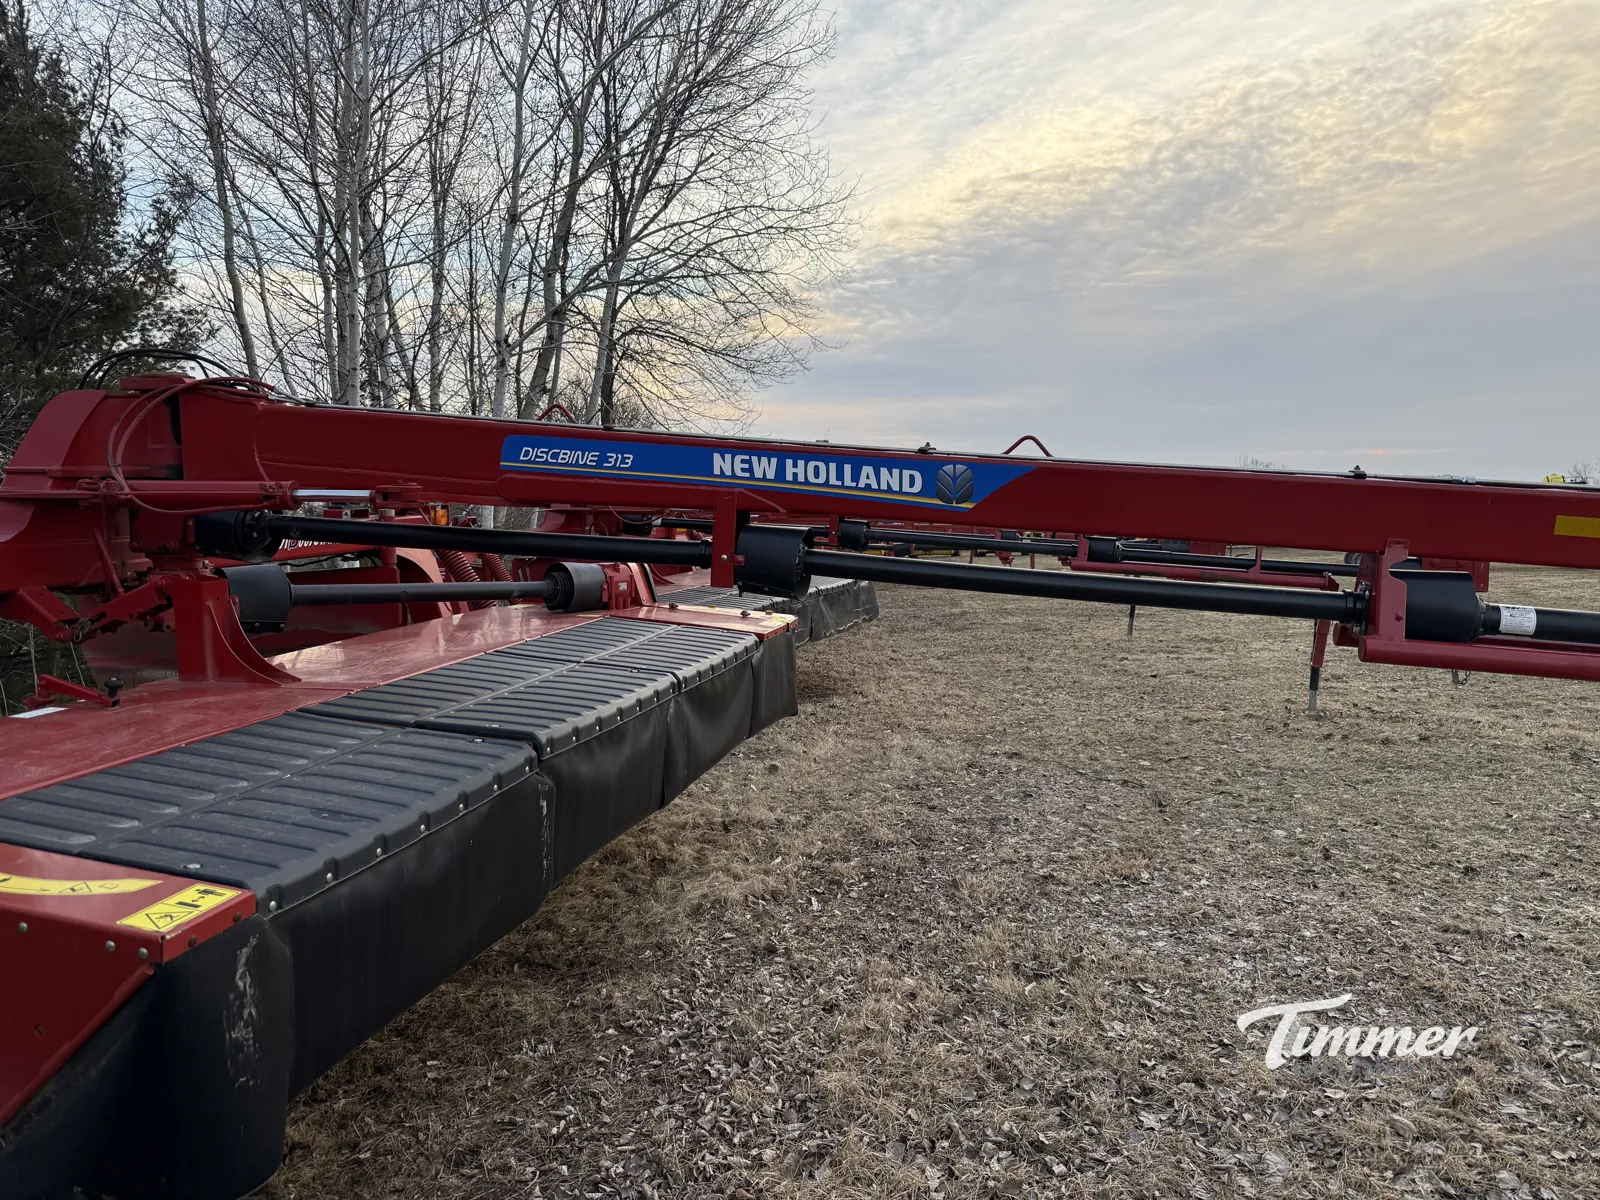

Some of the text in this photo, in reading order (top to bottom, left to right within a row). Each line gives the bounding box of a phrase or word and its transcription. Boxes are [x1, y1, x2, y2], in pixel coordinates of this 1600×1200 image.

[519, 446, 634, 468] DISCBINE 313
[713, 452, 923, 493] NEW HOLLAND
